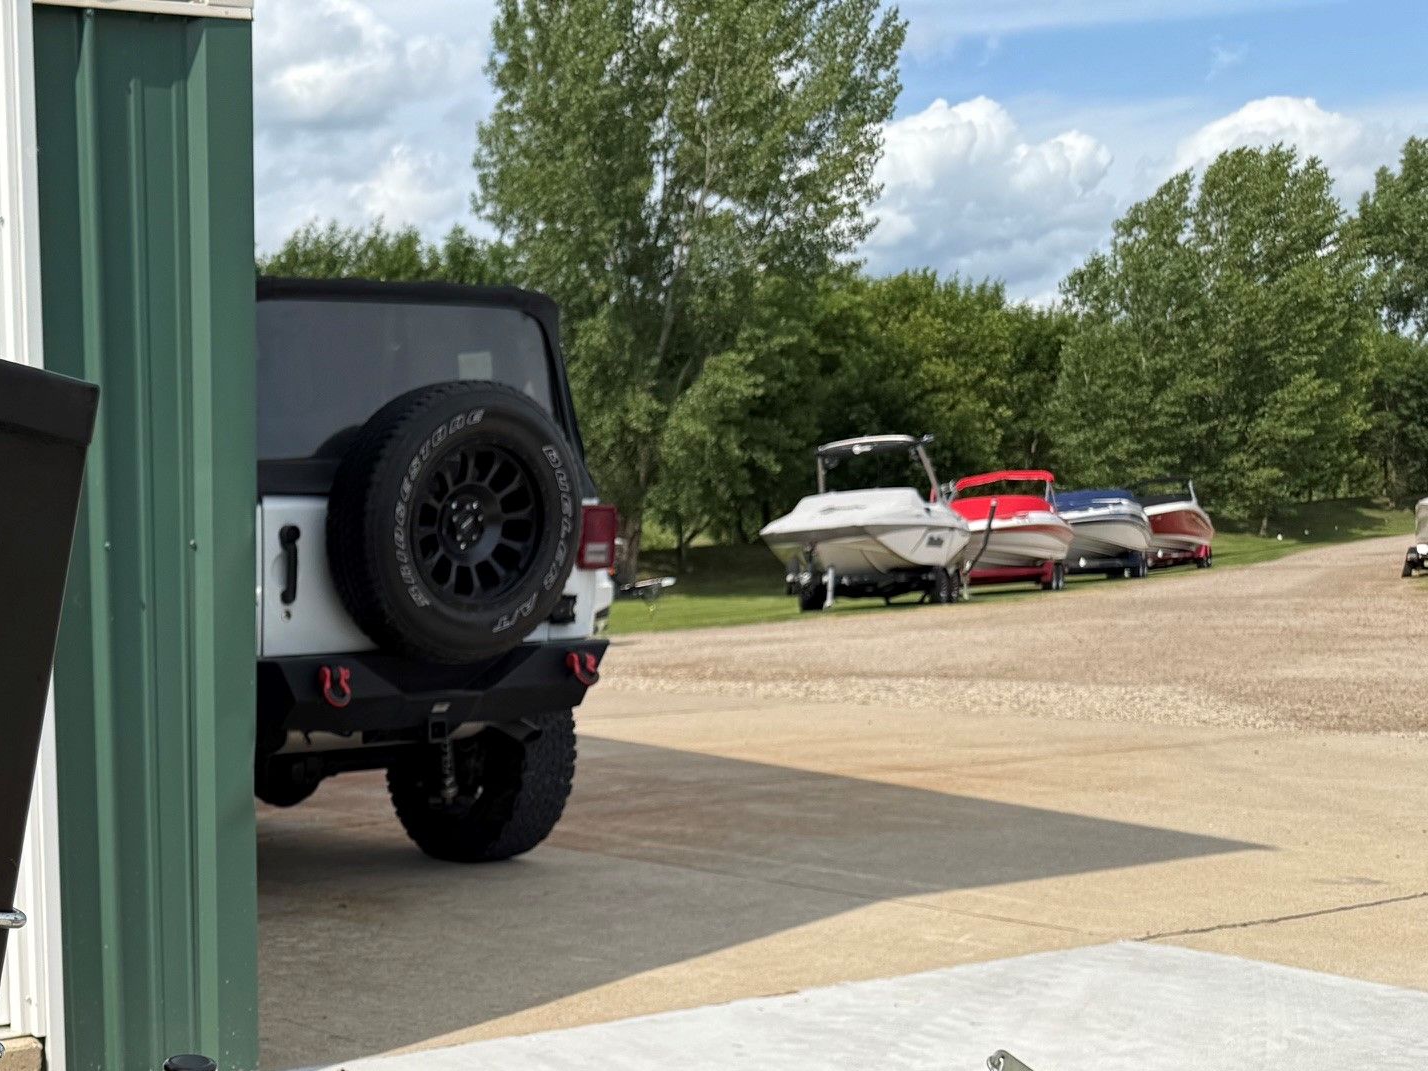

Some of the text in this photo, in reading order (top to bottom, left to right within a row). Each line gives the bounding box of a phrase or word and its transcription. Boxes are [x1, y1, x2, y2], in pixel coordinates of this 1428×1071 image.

[394, 408, 573, 633] BRIDGESTONE DUELER A/T
